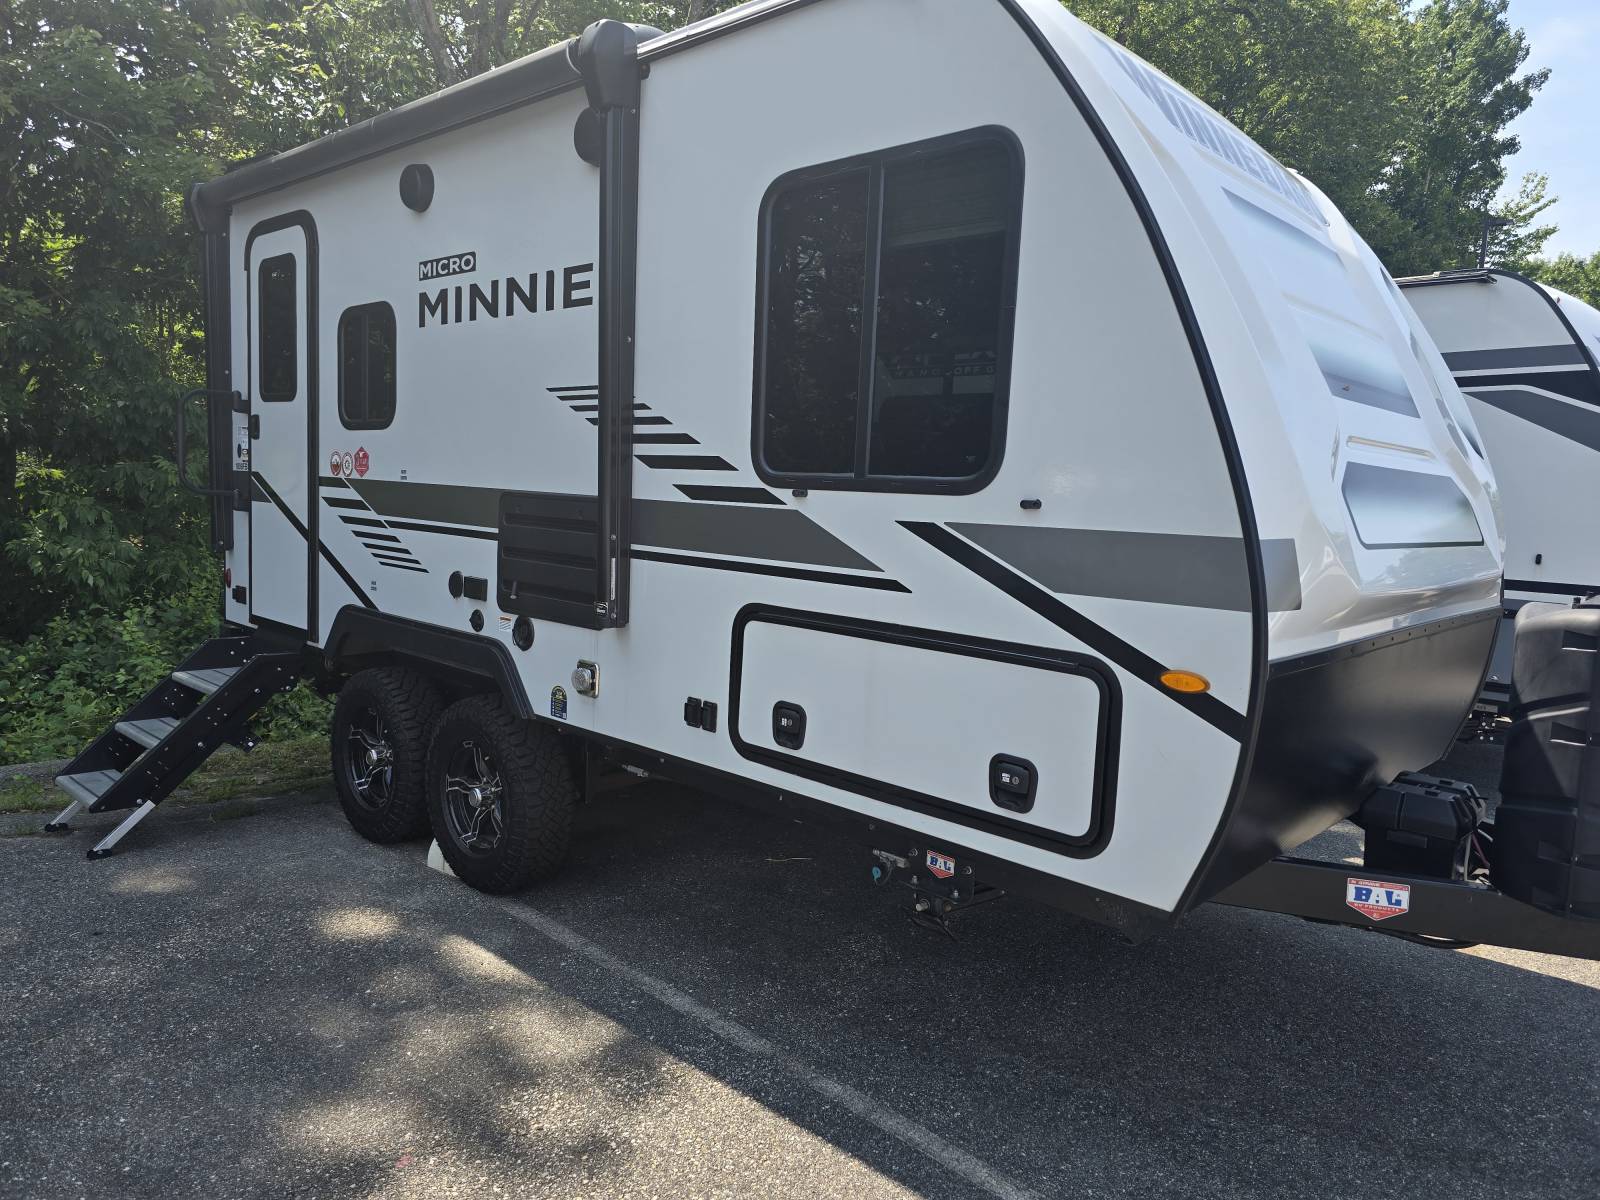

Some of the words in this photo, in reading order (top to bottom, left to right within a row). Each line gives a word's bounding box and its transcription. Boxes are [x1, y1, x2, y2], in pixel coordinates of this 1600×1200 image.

[419, 253, 475, 280] MICRO
[418, 263, 593, 328] MINNIE
[1353, 886, 1402, 907] BAL
